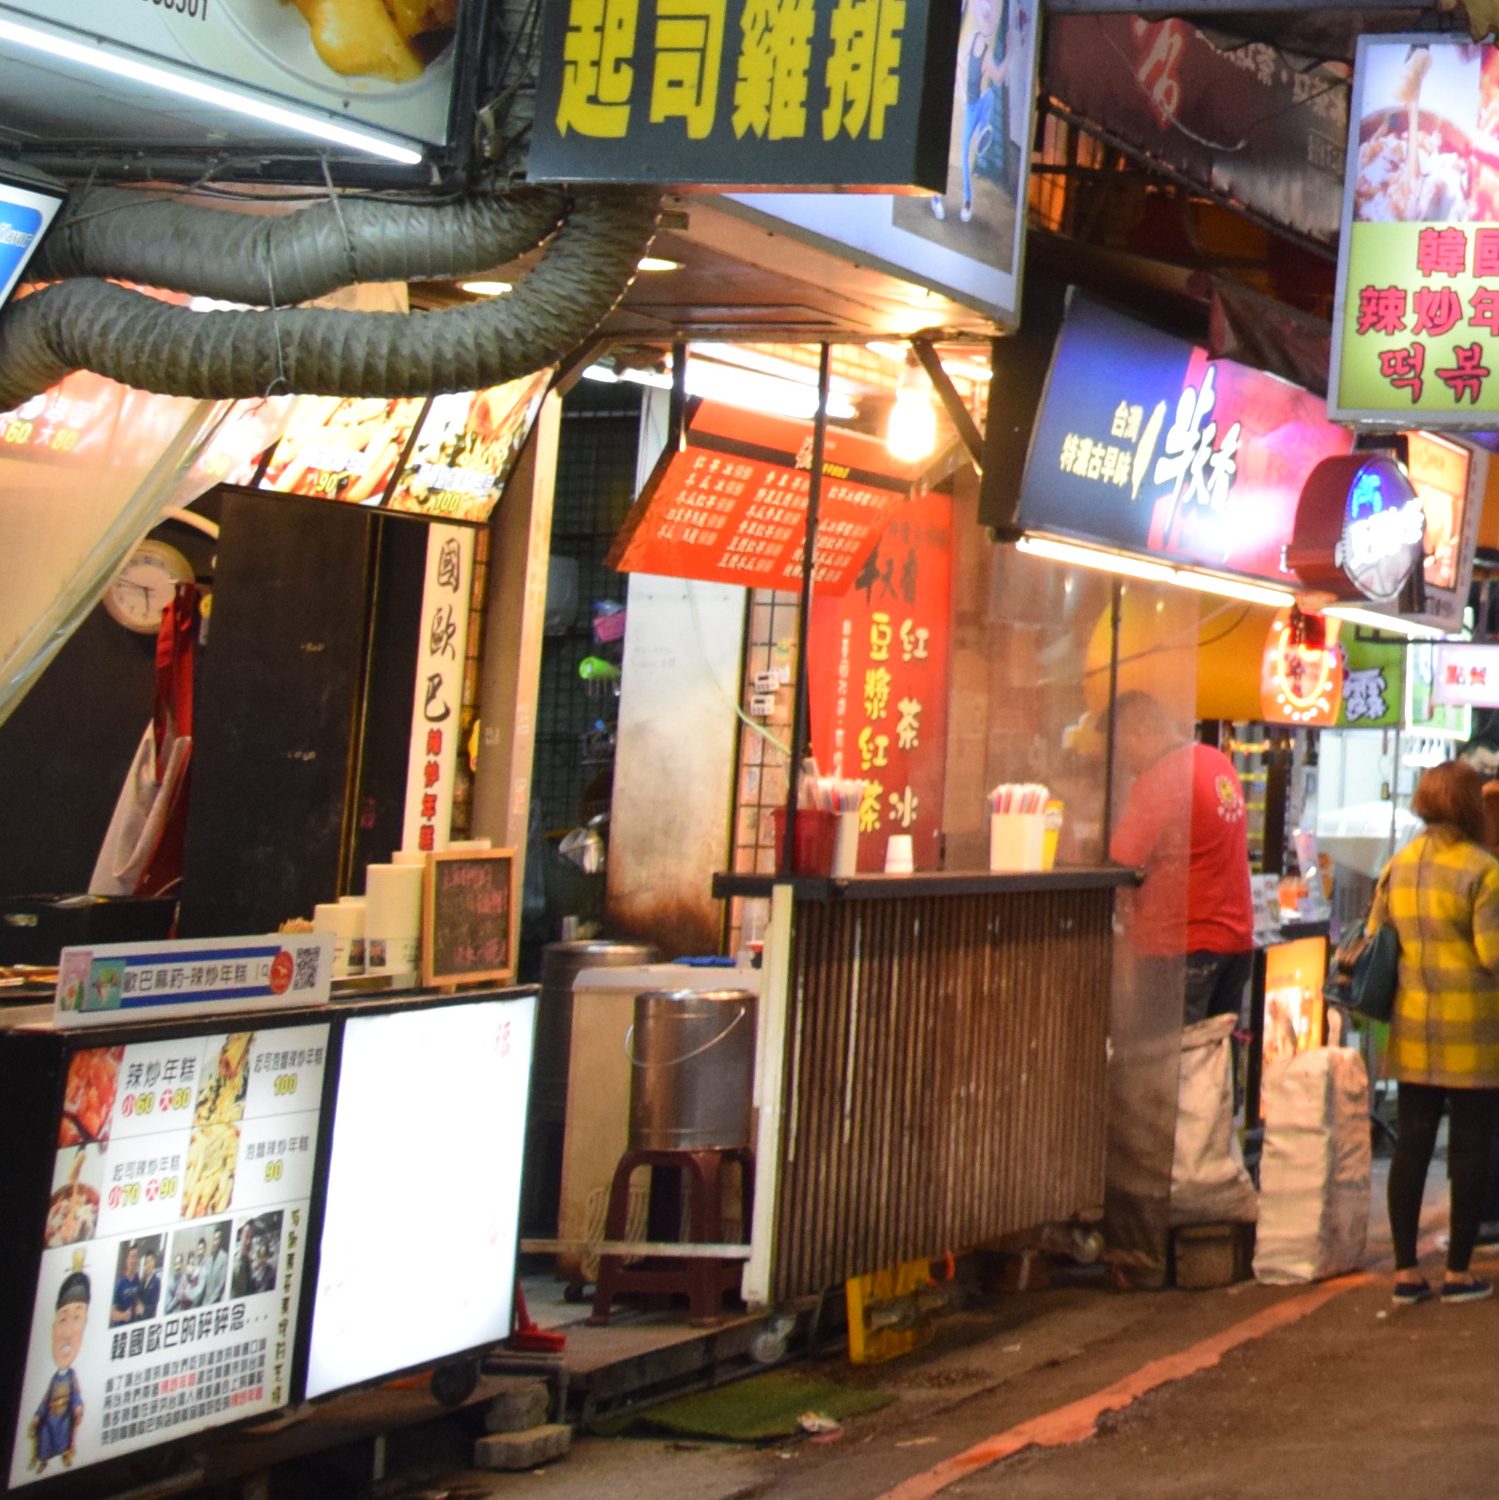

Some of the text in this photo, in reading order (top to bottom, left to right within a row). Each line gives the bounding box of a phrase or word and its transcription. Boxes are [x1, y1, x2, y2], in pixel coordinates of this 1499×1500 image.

[317, 473, 338, 493] 90
[435, 492, 460, 511] 100
[858, 612, 893, 833] 豆漿紅茶
[889, 618, 930, 828] 紅茶冰
[124, 1056, 197, 1090] 辣炒年糕
[273, 1073, 299, 1097] 100
[264, 1159, 284, 1182] 90
